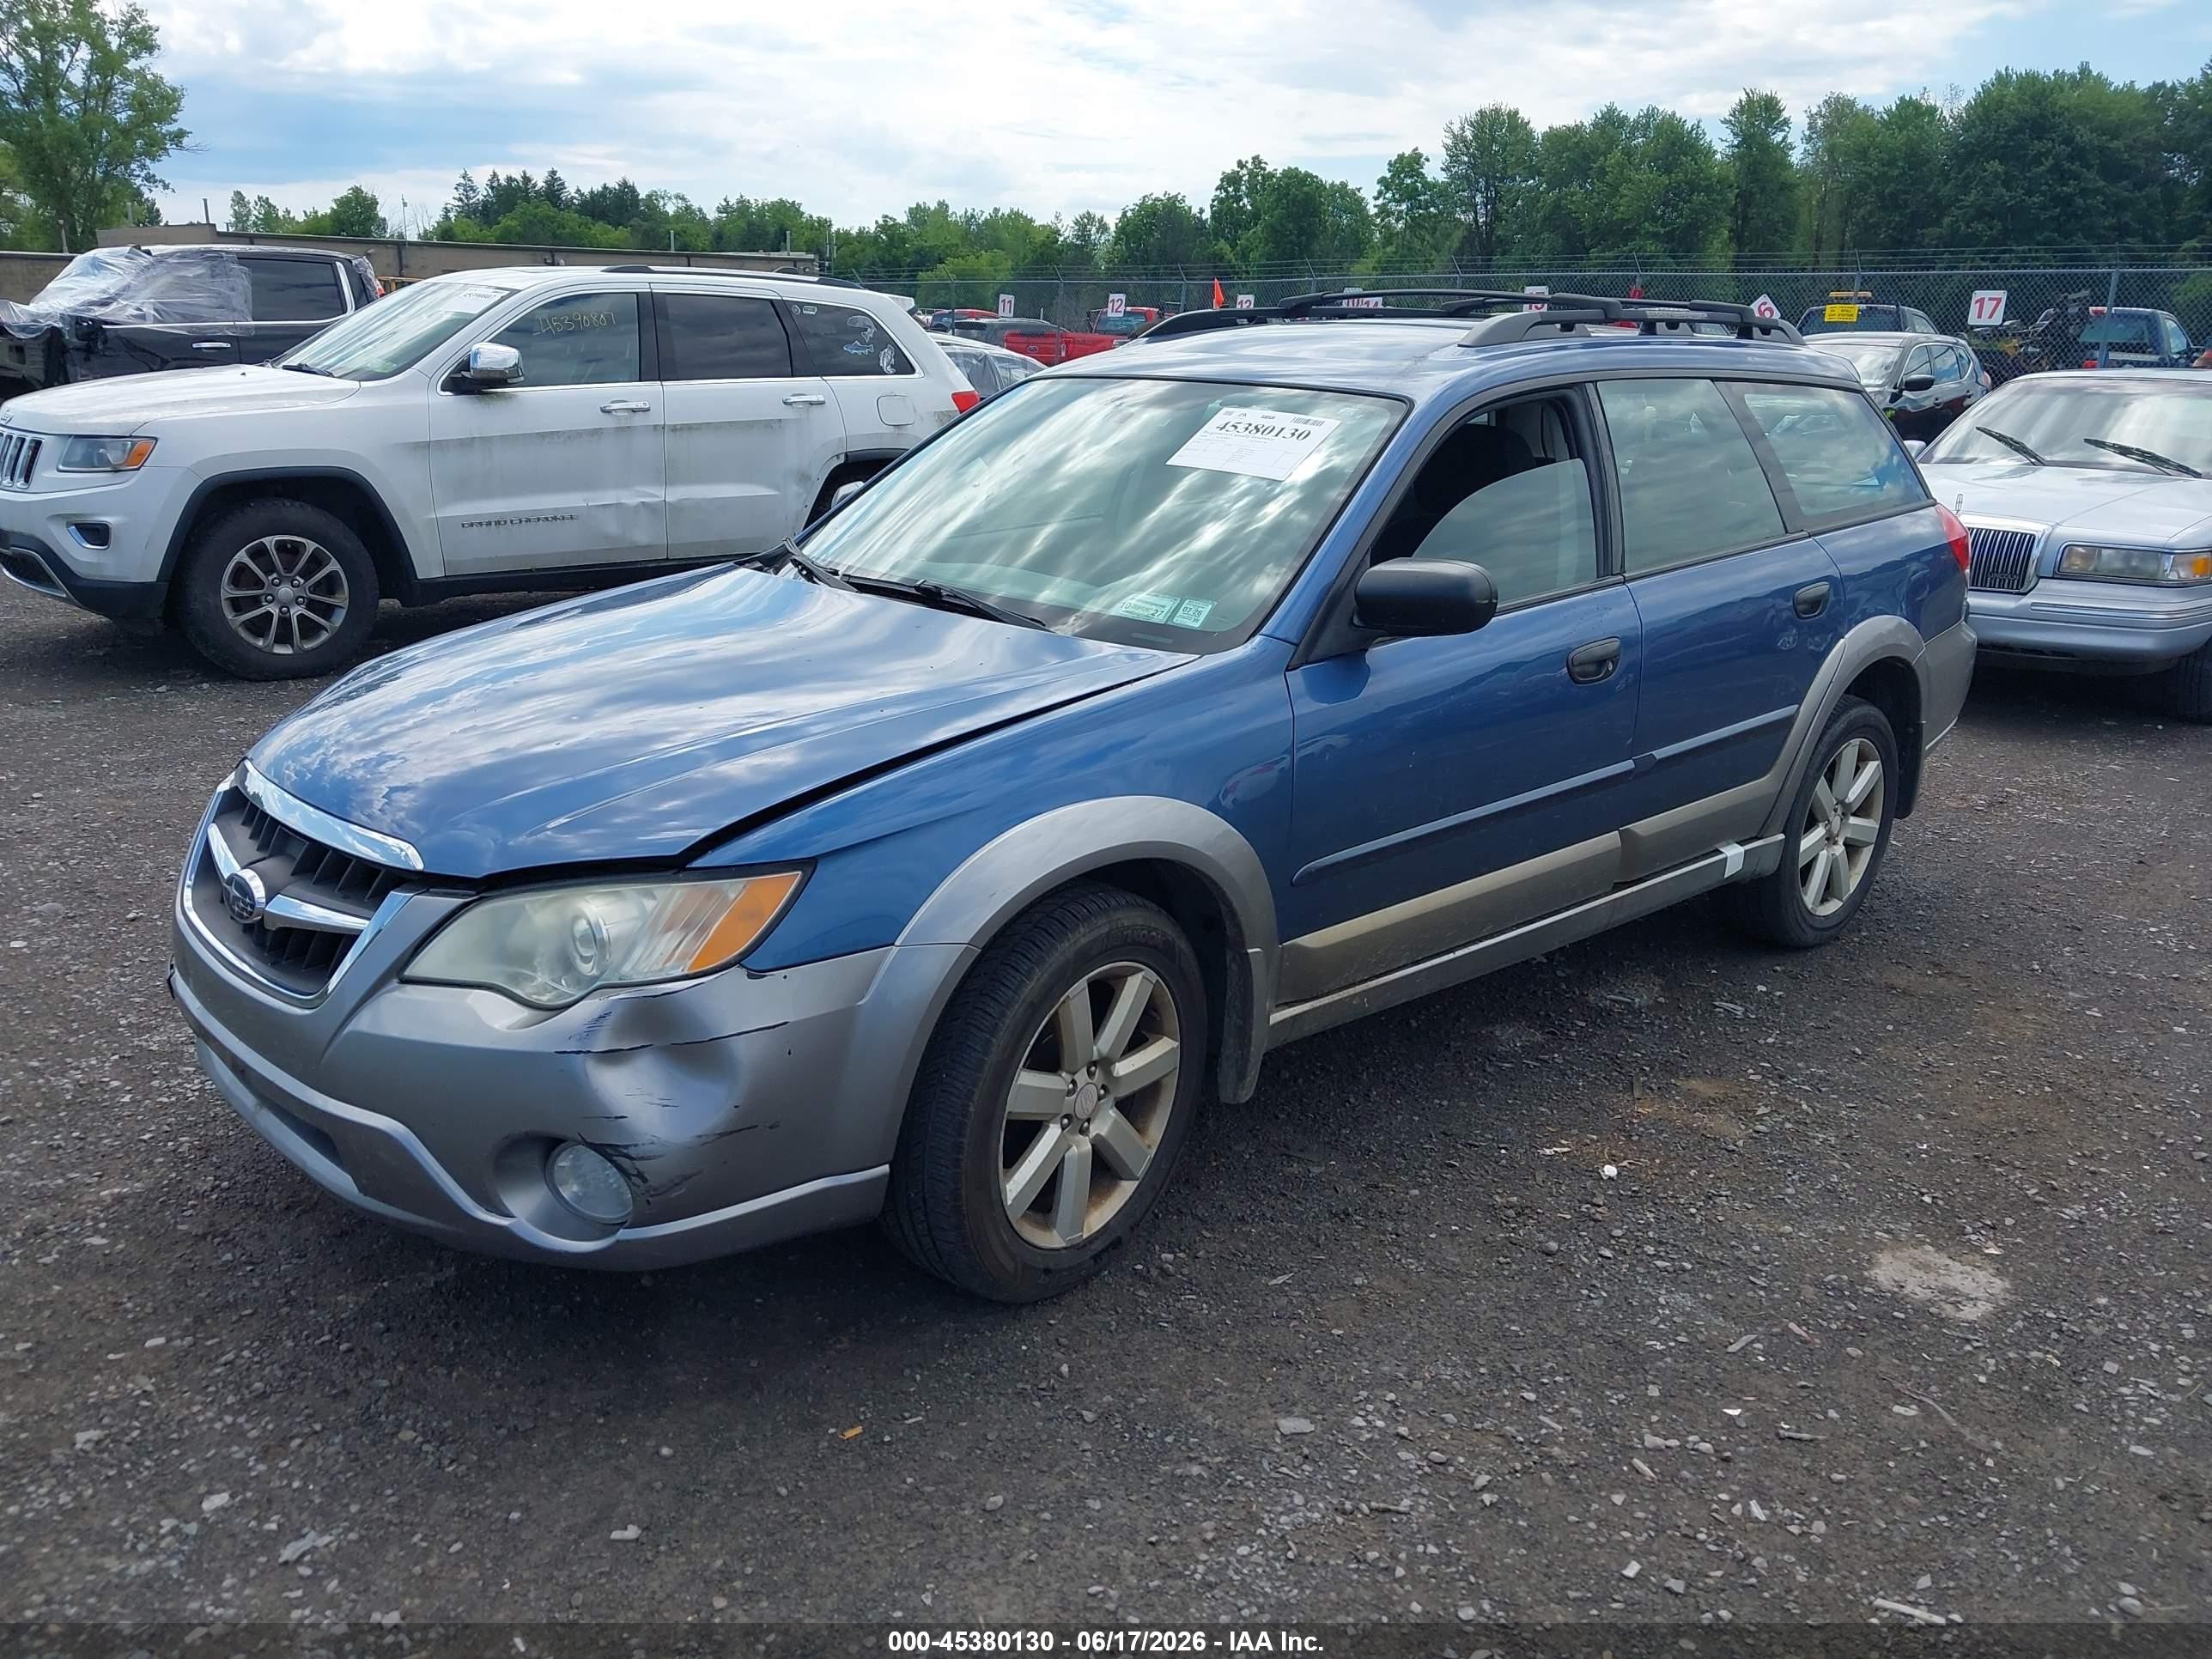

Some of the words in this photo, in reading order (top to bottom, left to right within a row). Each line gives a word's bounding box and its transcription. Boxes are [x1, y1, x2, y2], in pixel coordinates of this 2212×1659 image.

[1000, 298, 1012, 313] 11
[1109, 298, 1123, 313] 12
[1758, 301, 1774, 319] 6
[1974, 296, 2002, 319] 17
[537, 312, 616, 336] 45390807
[1216, 420, 1311, 441] 45380130
[461, 520, 507, 528] GRAND
[510, 514, 579, 525] CHEROKEE
[1151, 609, 1164, 617] 27
